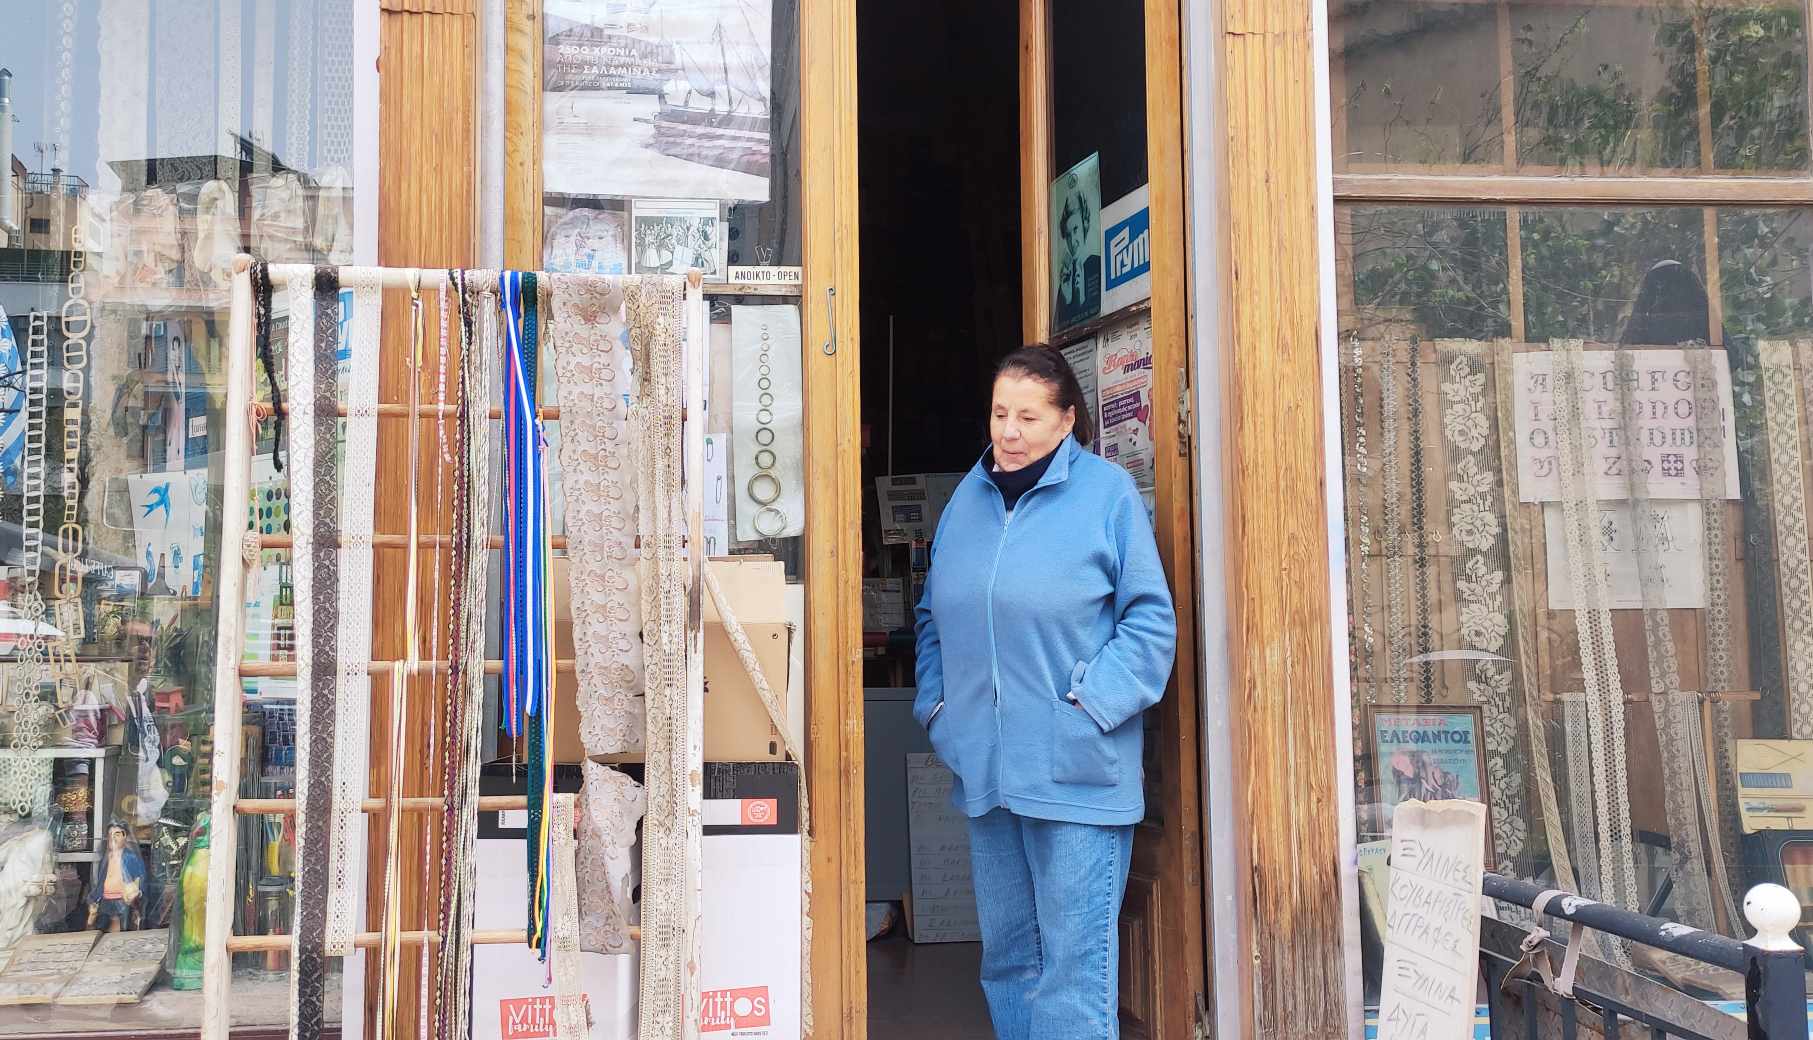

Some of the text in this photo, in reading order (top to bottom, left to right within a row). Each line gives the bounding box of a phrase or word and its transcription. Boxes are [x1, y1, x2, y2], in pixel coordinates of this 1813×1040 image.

[558, 45, 638, 56] 2500 ΧΡΟΝΙΑ
[583, 65, 659, 76] ΣΑΛΑΜΙΝΑΣ
[1110, 225, 1149, 280] Prym
[1380, 729, 1471, 745] ΕΛΕΦΑΝΤΟΣ
[1400, 839, 1473, 886] ΞΥΛΙΝΕΣ
